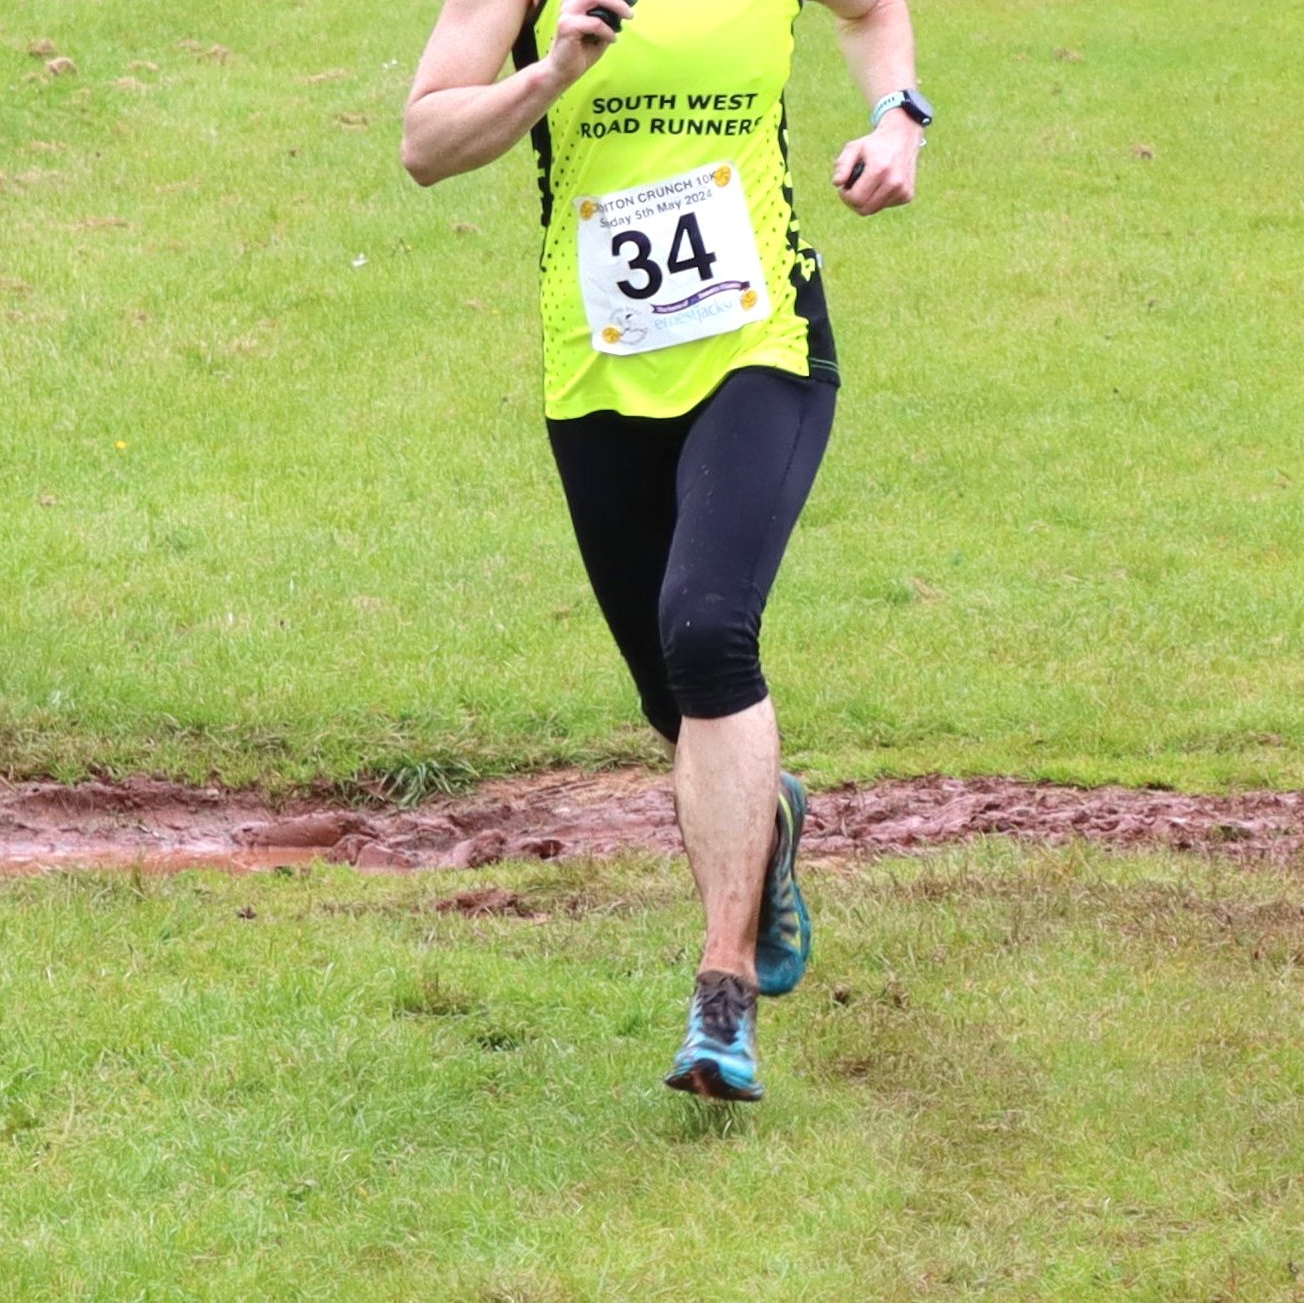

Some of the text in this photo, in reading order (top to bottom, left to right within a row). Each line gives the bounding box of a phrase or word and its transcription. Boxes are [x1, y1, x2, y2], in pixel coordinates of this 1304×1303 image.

[592, 93, 759, 114] SOUTH WEST
[580, 118, 640, 139] ROAD
[637, 179, 693, 203] CRUNCH
[635, 205, 655, 221] 5th
[657, 199, 682, 215] May
[685, 189, 713, 205] 2024
[611, 211, 718, 301] 34
